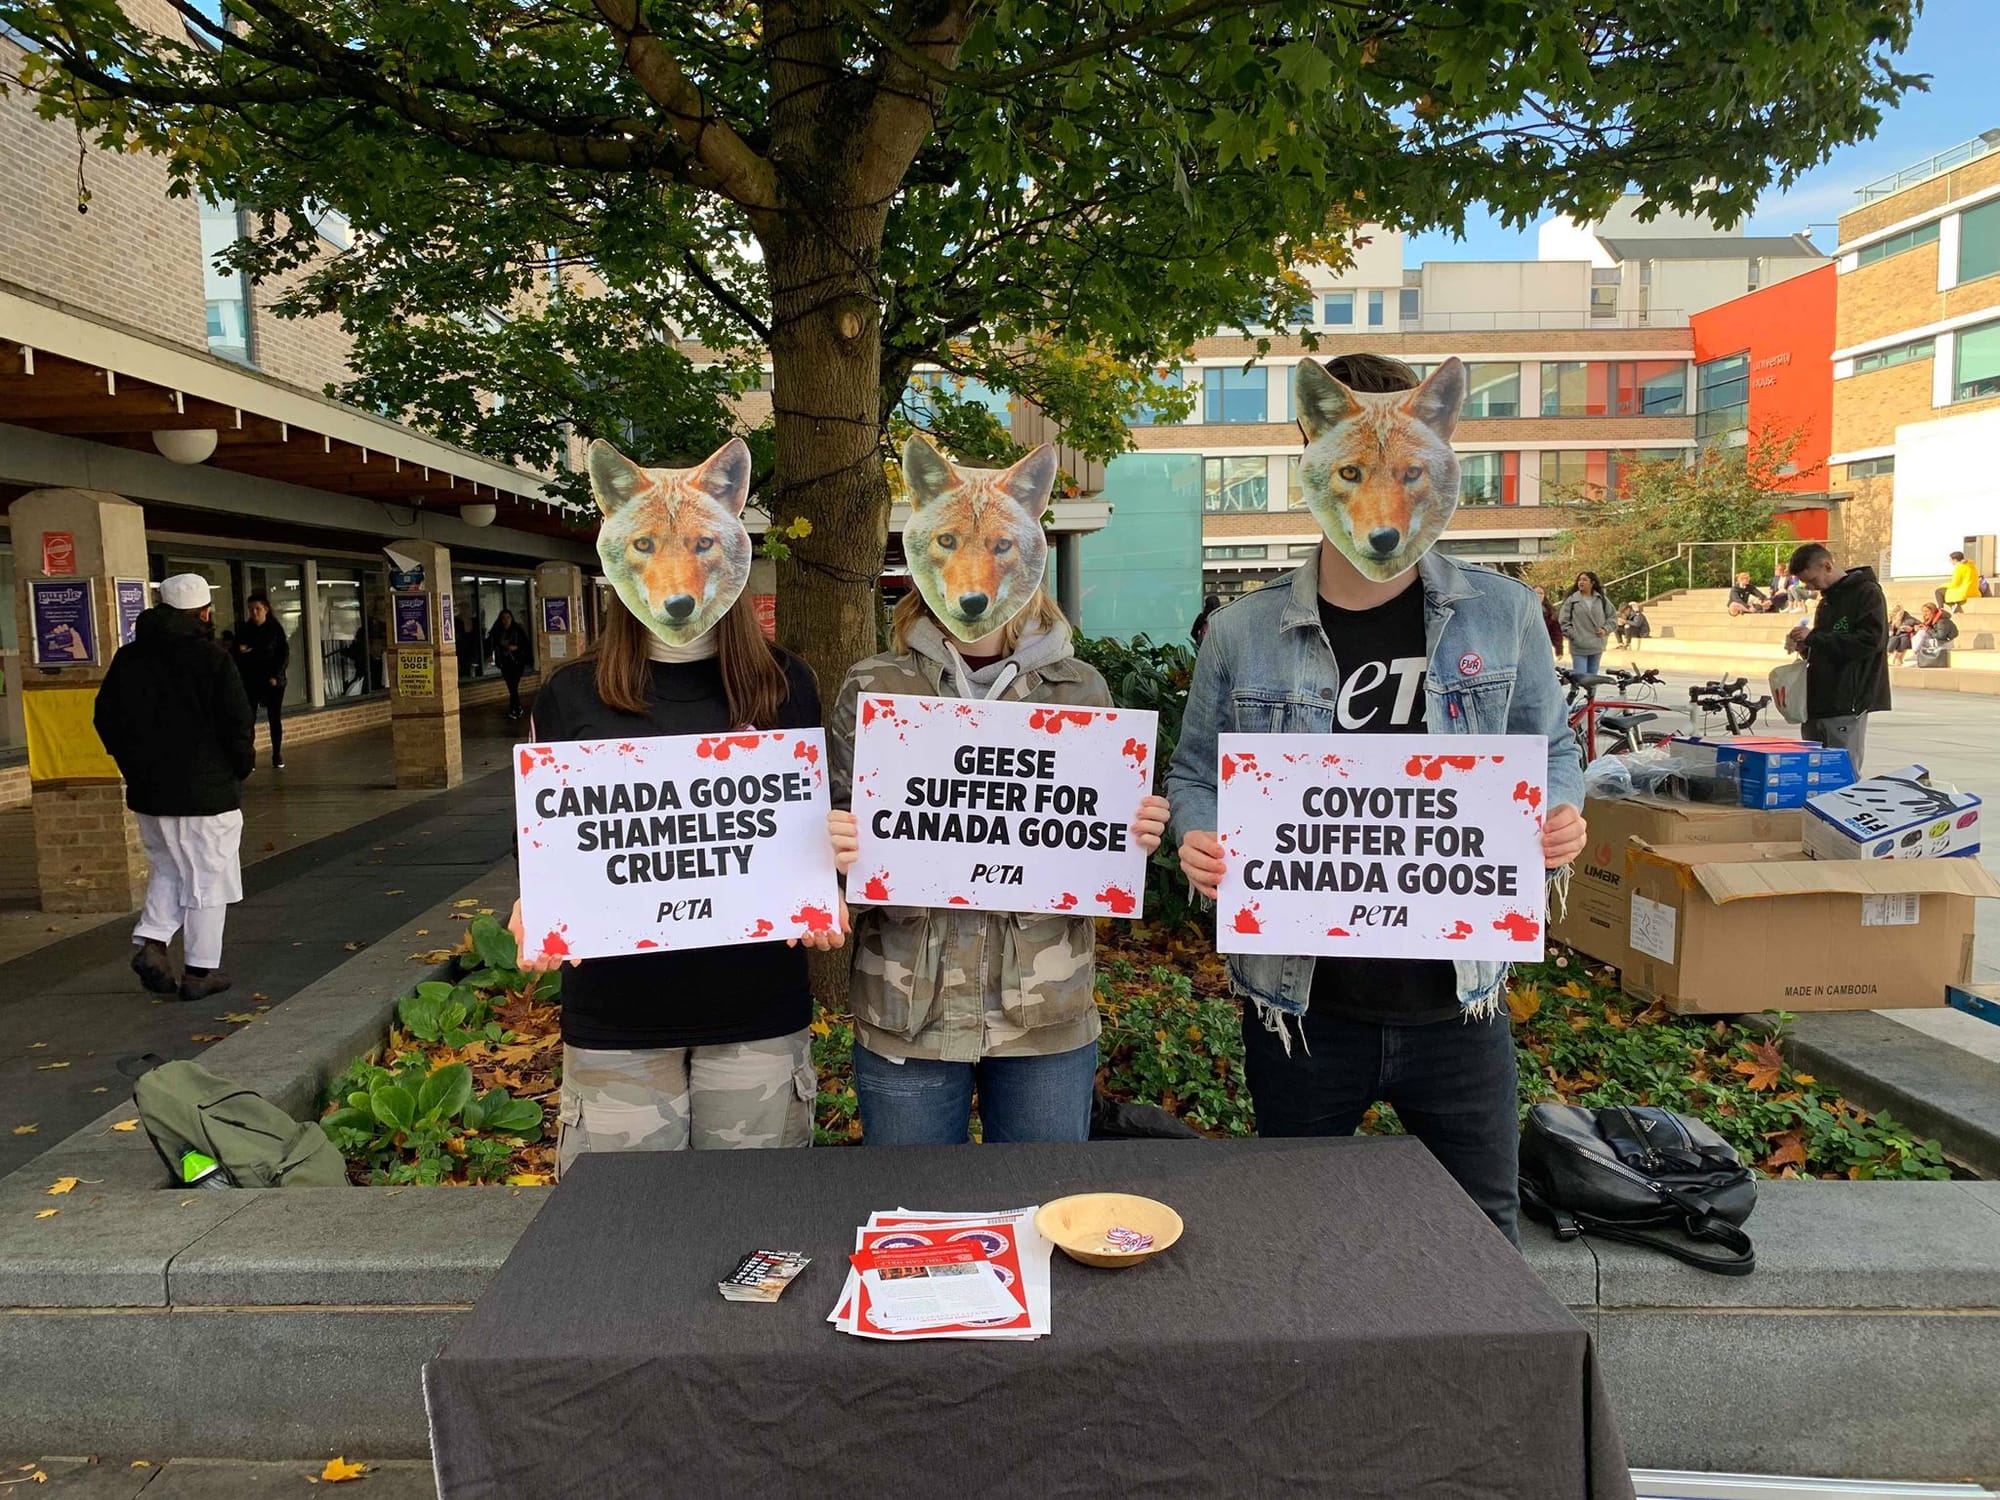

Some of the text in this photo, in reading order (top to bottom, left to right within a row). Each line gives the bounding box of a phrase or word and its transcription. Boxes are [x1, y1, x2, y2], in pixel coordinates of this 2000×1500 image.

[38, 588, 82, 605] purple
[1337, 656, 1427, 730] eT
[954, 745, 1056, 780] GEESE
[535, 773, 812, 819] CANADA GOOSE:
[905, 777, 1098, 816] SUFFER FOR
[1302, 786, 1458, 820] COYOTES
[577, 809, 777, 852] SHAMELESS
[872, 810, 1128, 853] CANADA GOOSE
[1275, 823, 1485, 858] SUFFER FOR
[1852, 813, 1889, 832] F15
[606, 845, 754, 885] CRUELTY
[1243, 859, 1519, 897] CANADA GOOSE
[1785, 984, 1877, 996] MADE IN CAMBODIA
